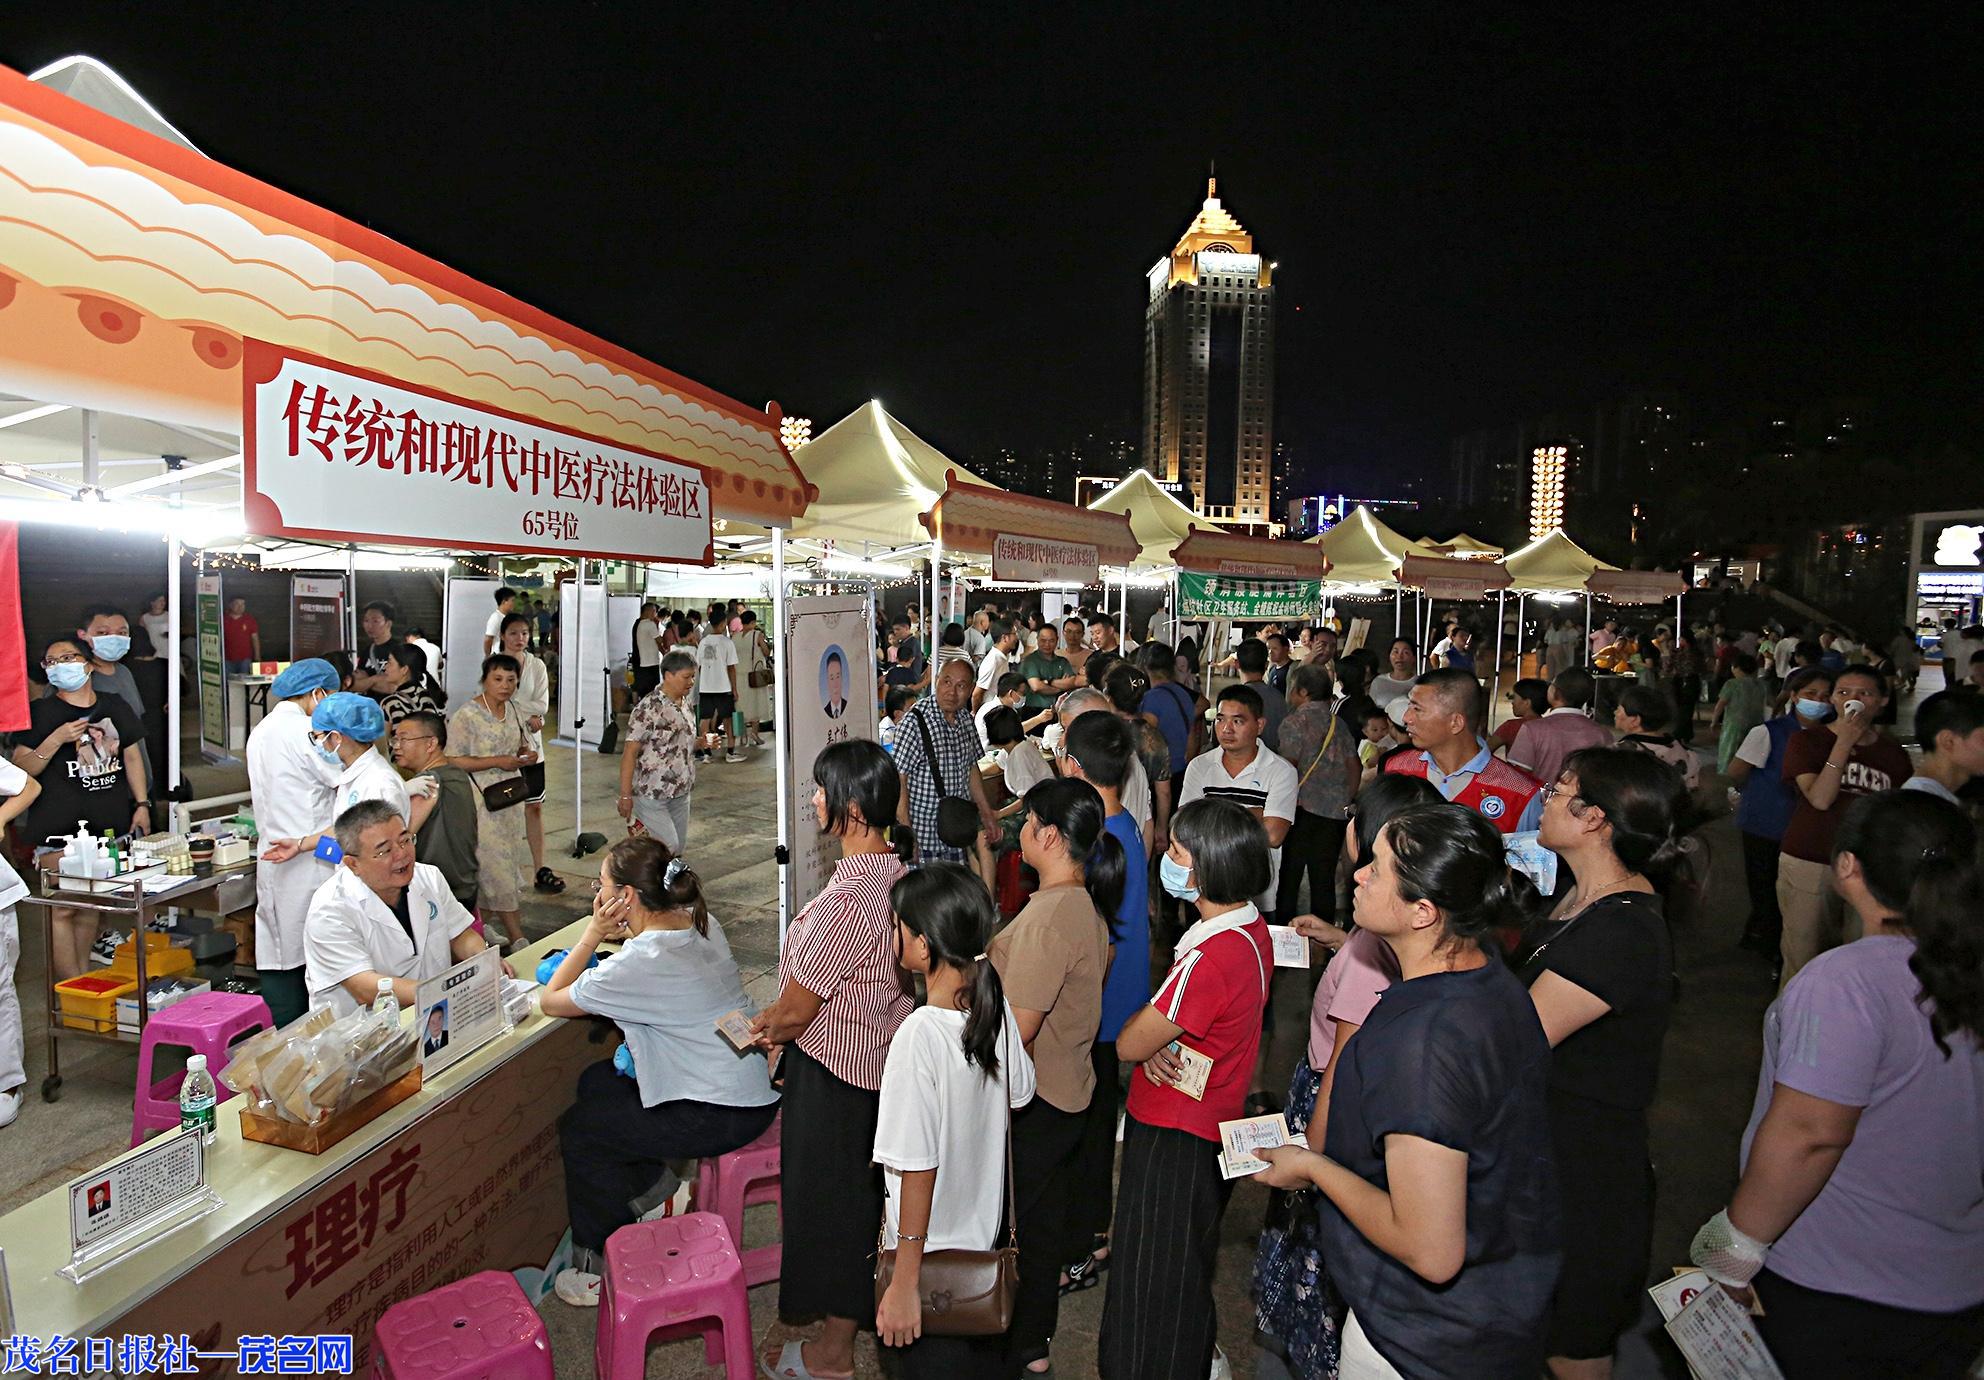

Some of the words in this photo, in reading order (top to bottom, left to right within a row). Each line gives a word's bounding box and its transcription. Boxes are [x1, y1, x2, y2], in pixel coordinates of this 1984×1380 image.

[282, 379, 702, 519] 传统和现代中医疗法体验区
[522, 510, 579, 541] 65号位
[82, 774, 116, 788] Sense
[285, 1143, 421, 1300] 理疗
